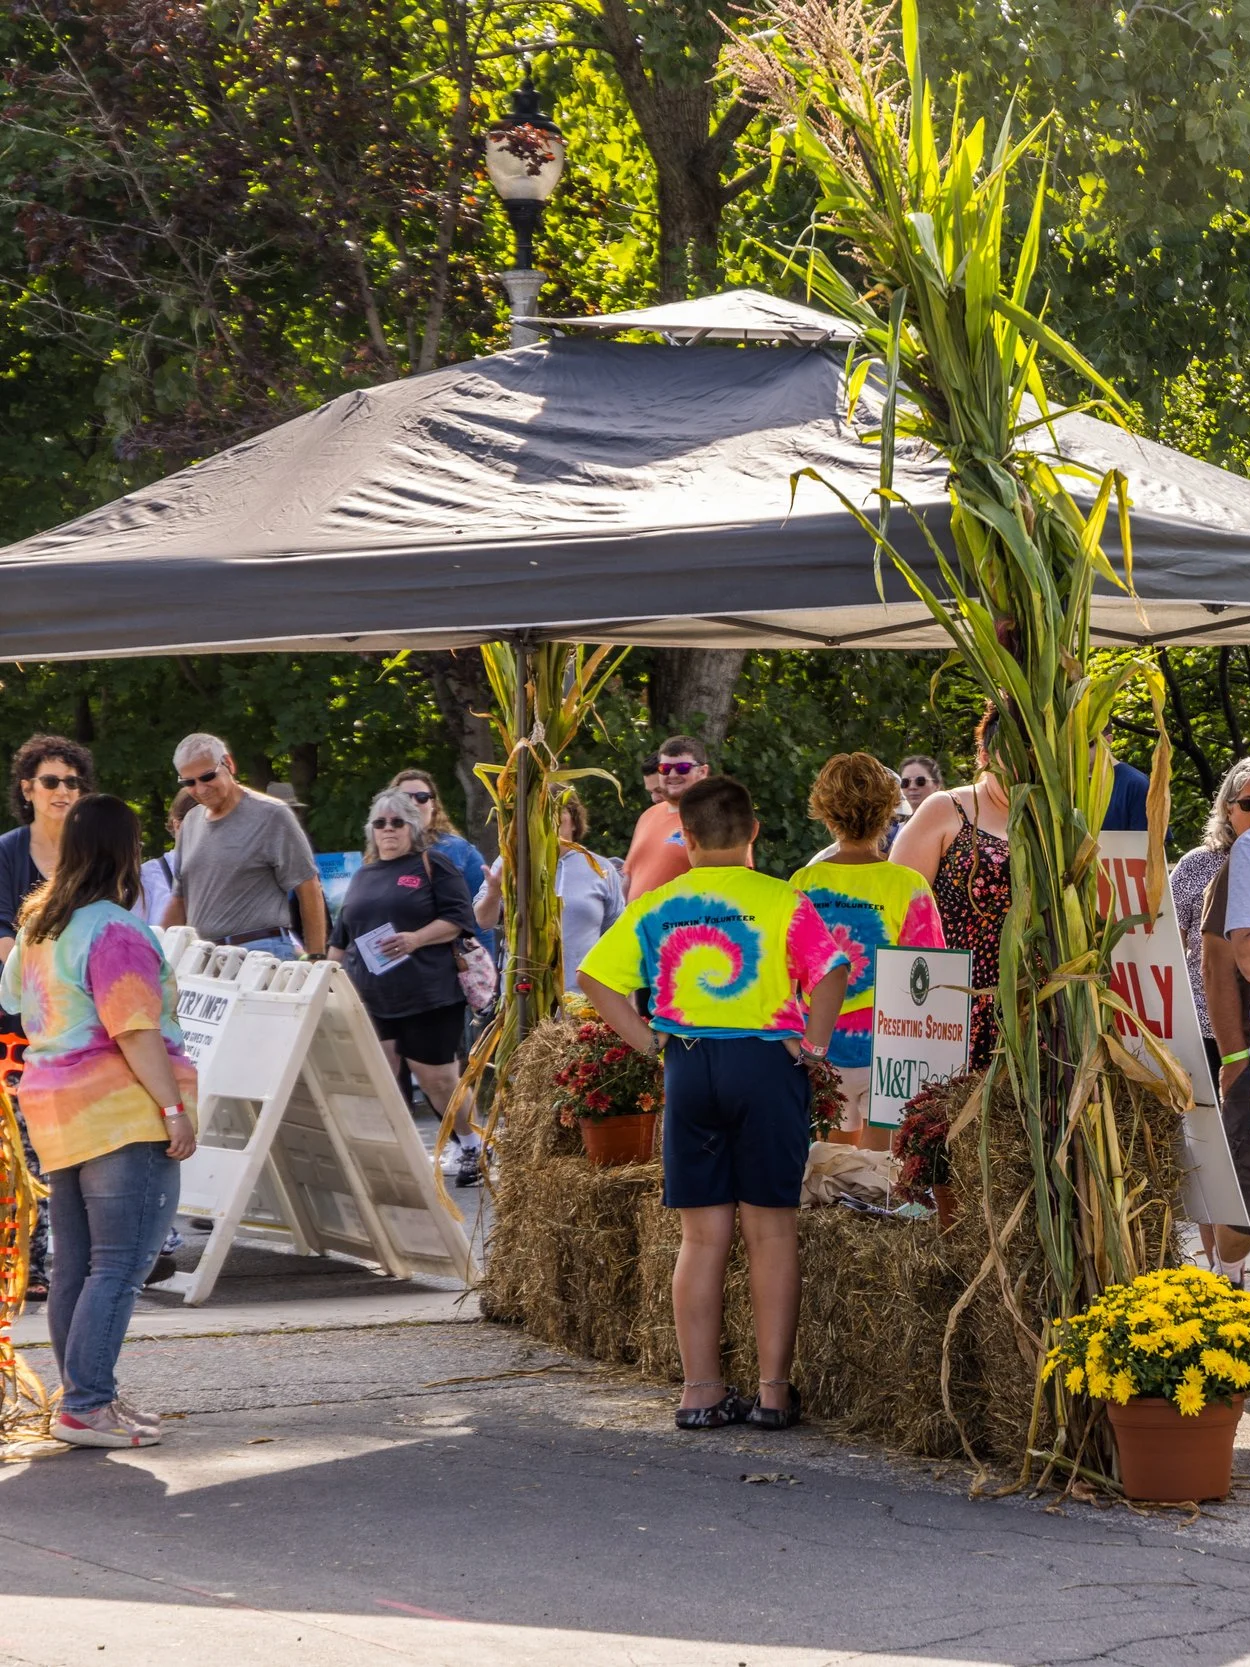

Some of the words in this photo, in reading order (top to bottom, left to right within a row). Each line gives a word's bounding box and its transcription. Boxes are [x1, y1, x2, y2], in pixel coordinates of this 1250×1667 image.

[835, 901, 885, 911] VOLUNTEER
[662, 916, 702, 930] STINKIN'
[705, 915, 756, 924] VOLUNTEER
[198, 994, 229, 1021] INFO
[877, 1010, 923, 1038] PRESENTING
[925, 1014, 963, 1042] SPONSOR
[875, 1056, 917, 1099] M&T
